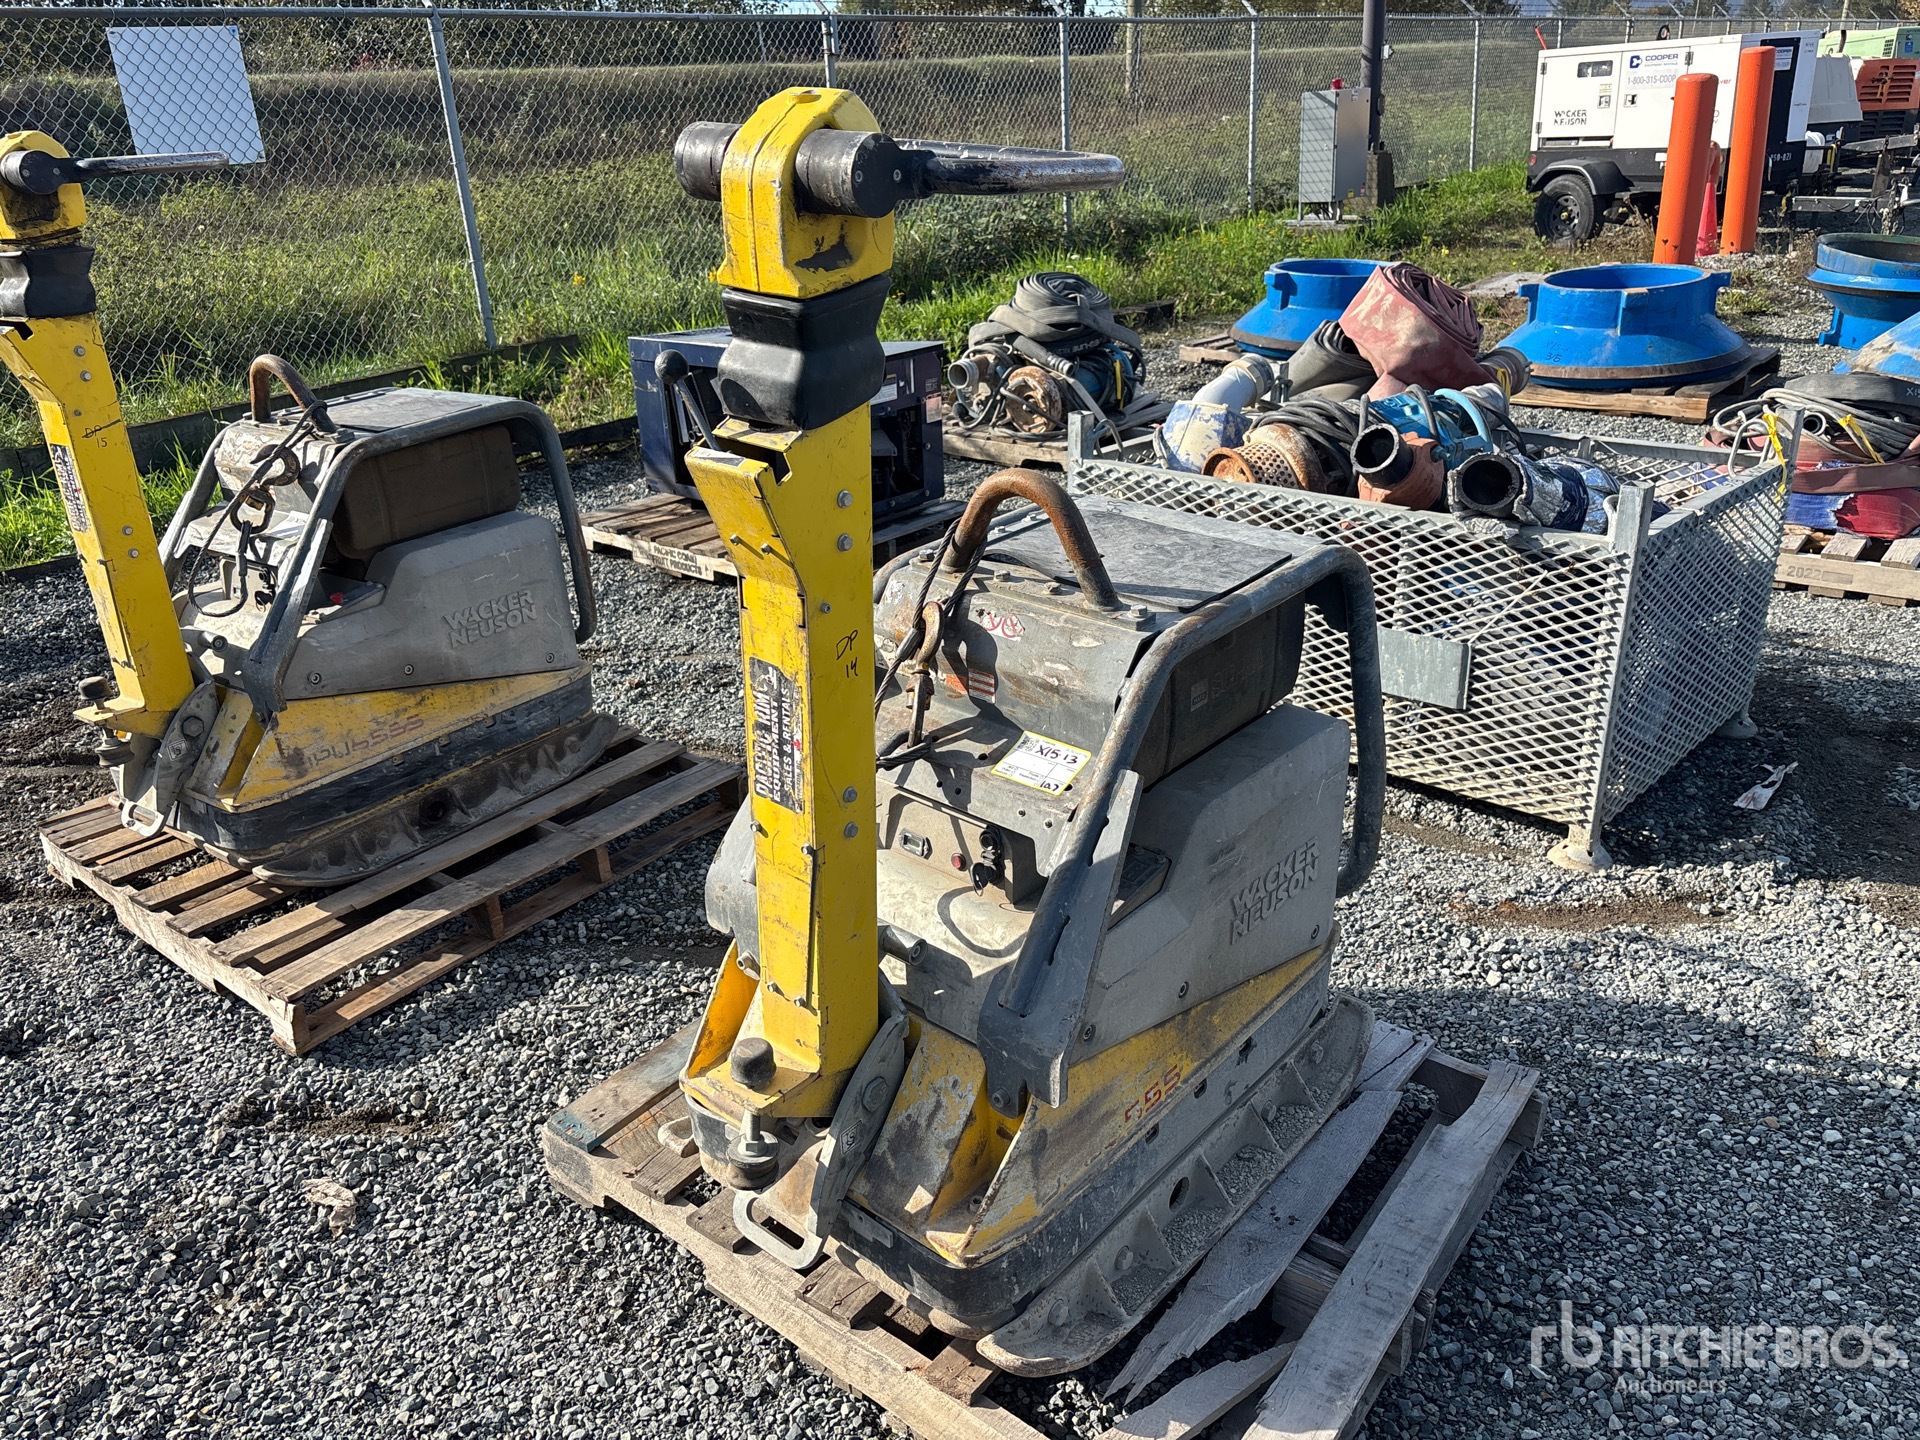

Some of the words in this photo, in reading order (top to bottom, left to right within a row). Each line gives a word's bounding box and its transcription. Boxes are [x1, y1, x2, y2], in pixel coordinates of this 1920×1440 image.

[1645, 53, 1679, 62] COOPER
[1554, 109, 1588, 118] WACKER
[96, 437, 108, 449] 15
[1786, 565, 1821, 580] 2022
[441, 589, 536, 631] WACKER
[449, 604, 538, 650] NEUSON
[835, 629, 859, 660] DP
[845, 656, 859, 679] 14
[753, 690, 772, 726] RIM
[780, 687, 792, 741] RENTALS
[769, 697, 781, 803] EQUIPMENT
[783, 743, 792, 754] &
[782, 755, 793, 792] SALES
[1229, 842, 1319, 918] WACKER
[1229, 860, 1318, 946] NEUSON
